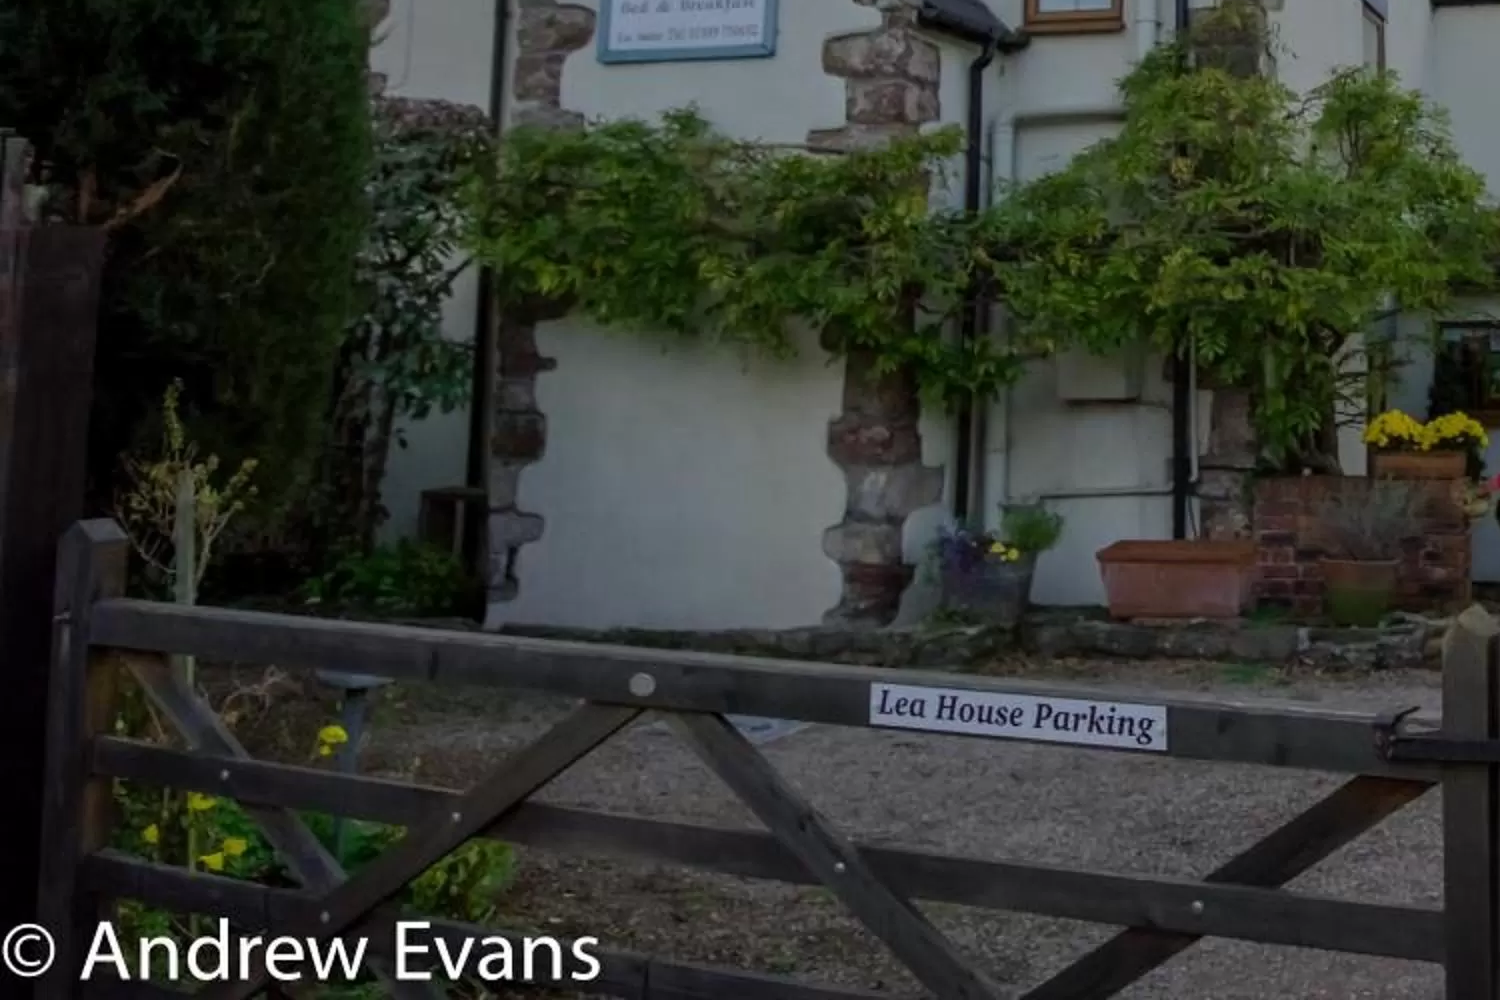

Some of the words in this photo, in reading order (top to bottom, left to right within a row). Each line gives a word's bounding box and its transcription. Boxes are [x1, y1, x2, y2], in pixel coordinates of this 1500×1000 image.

[878, 689, 926, 718] Lea
[935, 694, 1024, 727] House
[1032, 703, 1155, 745] Parking
